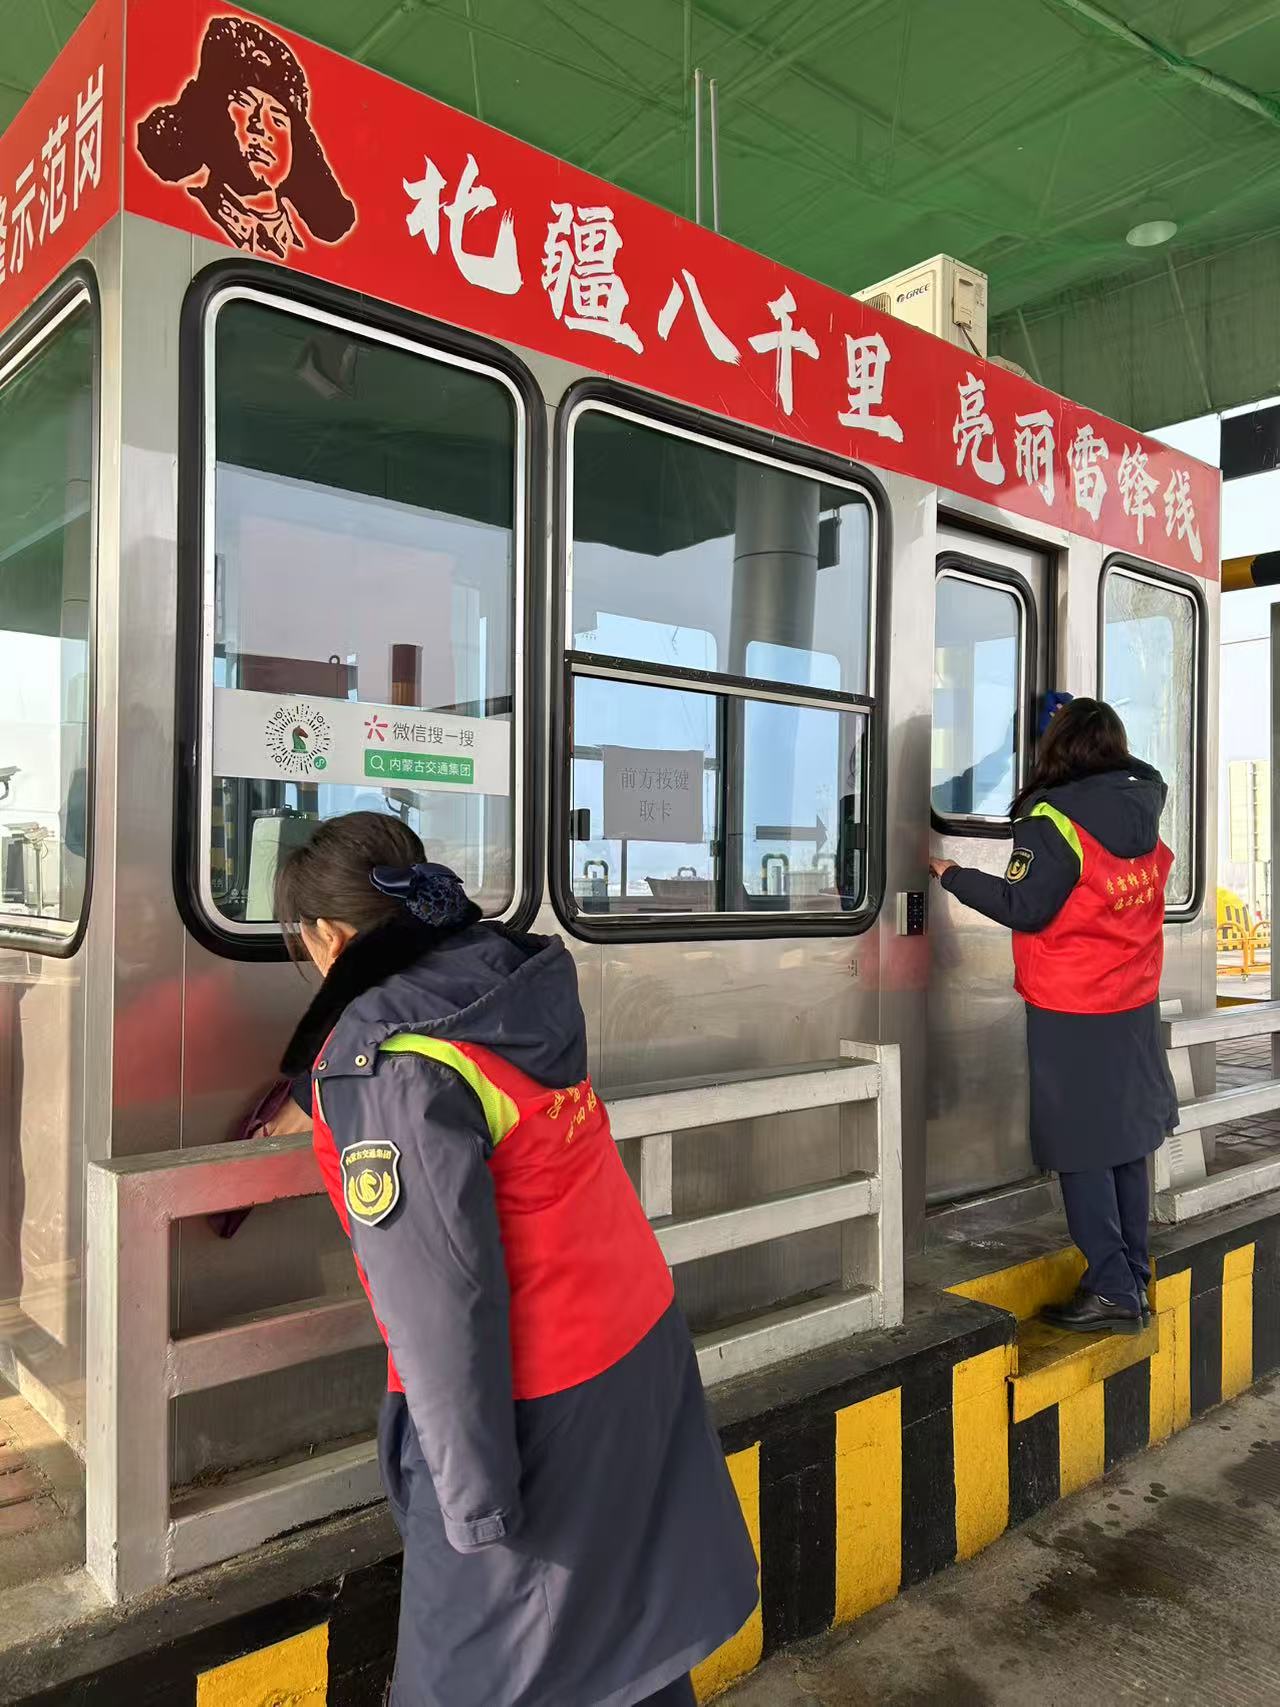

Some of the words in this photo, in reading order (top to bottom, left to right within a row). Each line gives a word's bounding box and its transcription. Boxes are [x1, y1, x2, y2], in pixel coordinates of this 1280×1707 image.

[905, 283, 931, 300] GREE
[403, 153, 904, 443] 北疆八千里
[952, 371, 1203, 563] 亮丽雷锋线
[392, 722, 474, 747] 微信搜一搜
[389, 758, 471, 777] 内蒙古交通集团
[619, 767, 689, 791] 前方按键
[639, 799, 672, 821] 取卡
